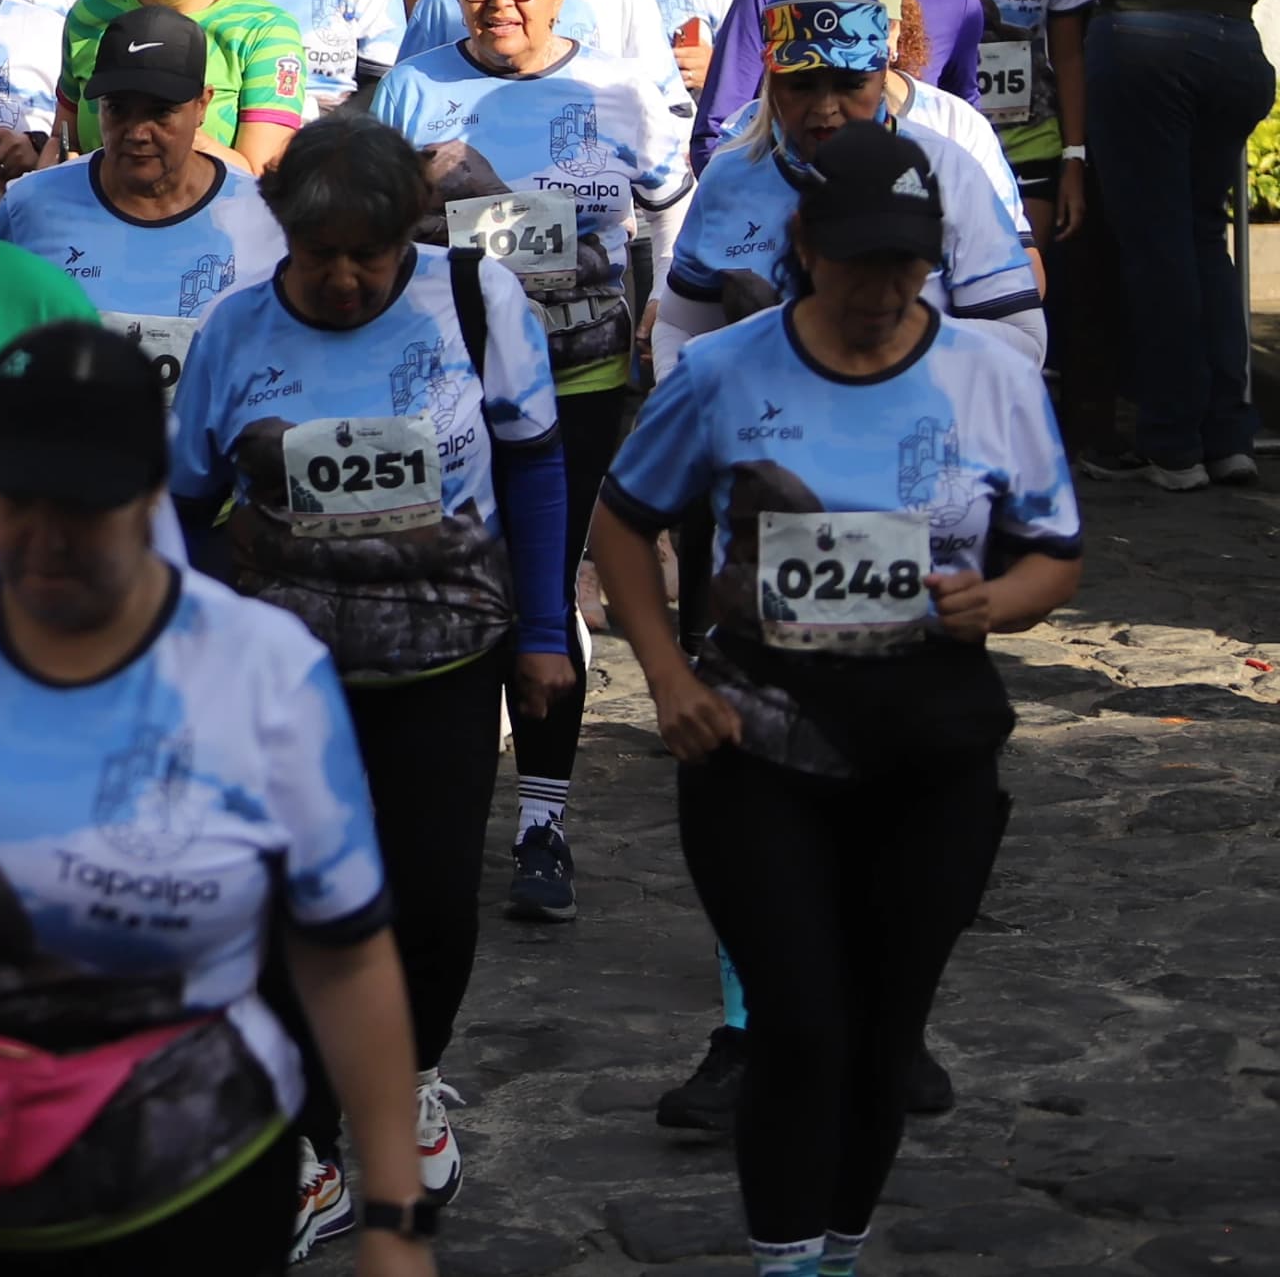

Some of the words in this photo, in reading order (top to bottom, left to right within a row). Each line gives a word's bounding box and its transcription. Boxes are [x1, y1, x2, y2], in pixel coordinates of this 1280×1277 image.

[978, 68, 1025, 95] 015
[426, 113, 480, 132] sporelli
[470, 223, 564, 256] 1041
[725, 238, 777, 258] sporelli
[247, 379, 303, 407] sporelli
[437, 426, 476, 458] alpa
[737, 425, 804, 443] sporelli
[307, 448, 426, 493] 0251
[776, 558, 922, 601] 0248
[52, 846, 222, 907] Tapalpa
